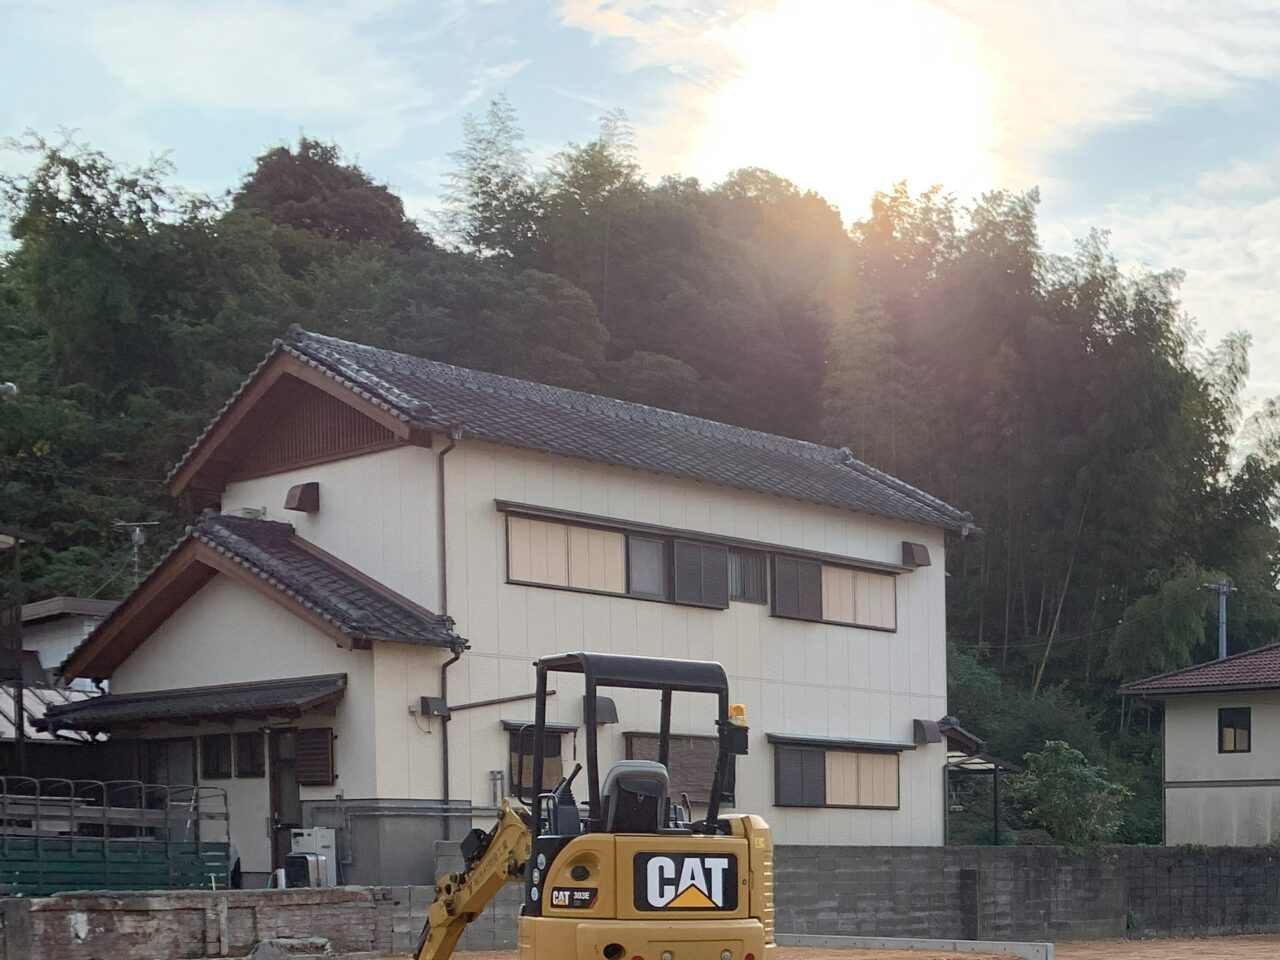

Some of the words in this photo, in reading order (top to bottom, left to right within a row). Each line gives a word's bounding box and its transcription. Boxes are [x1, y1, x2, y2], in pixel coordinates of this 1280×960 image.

[552, 890, 570, 906] CAT
[573, 891, 590, 900] 303E
[646, 856, 728, 908] CAT
